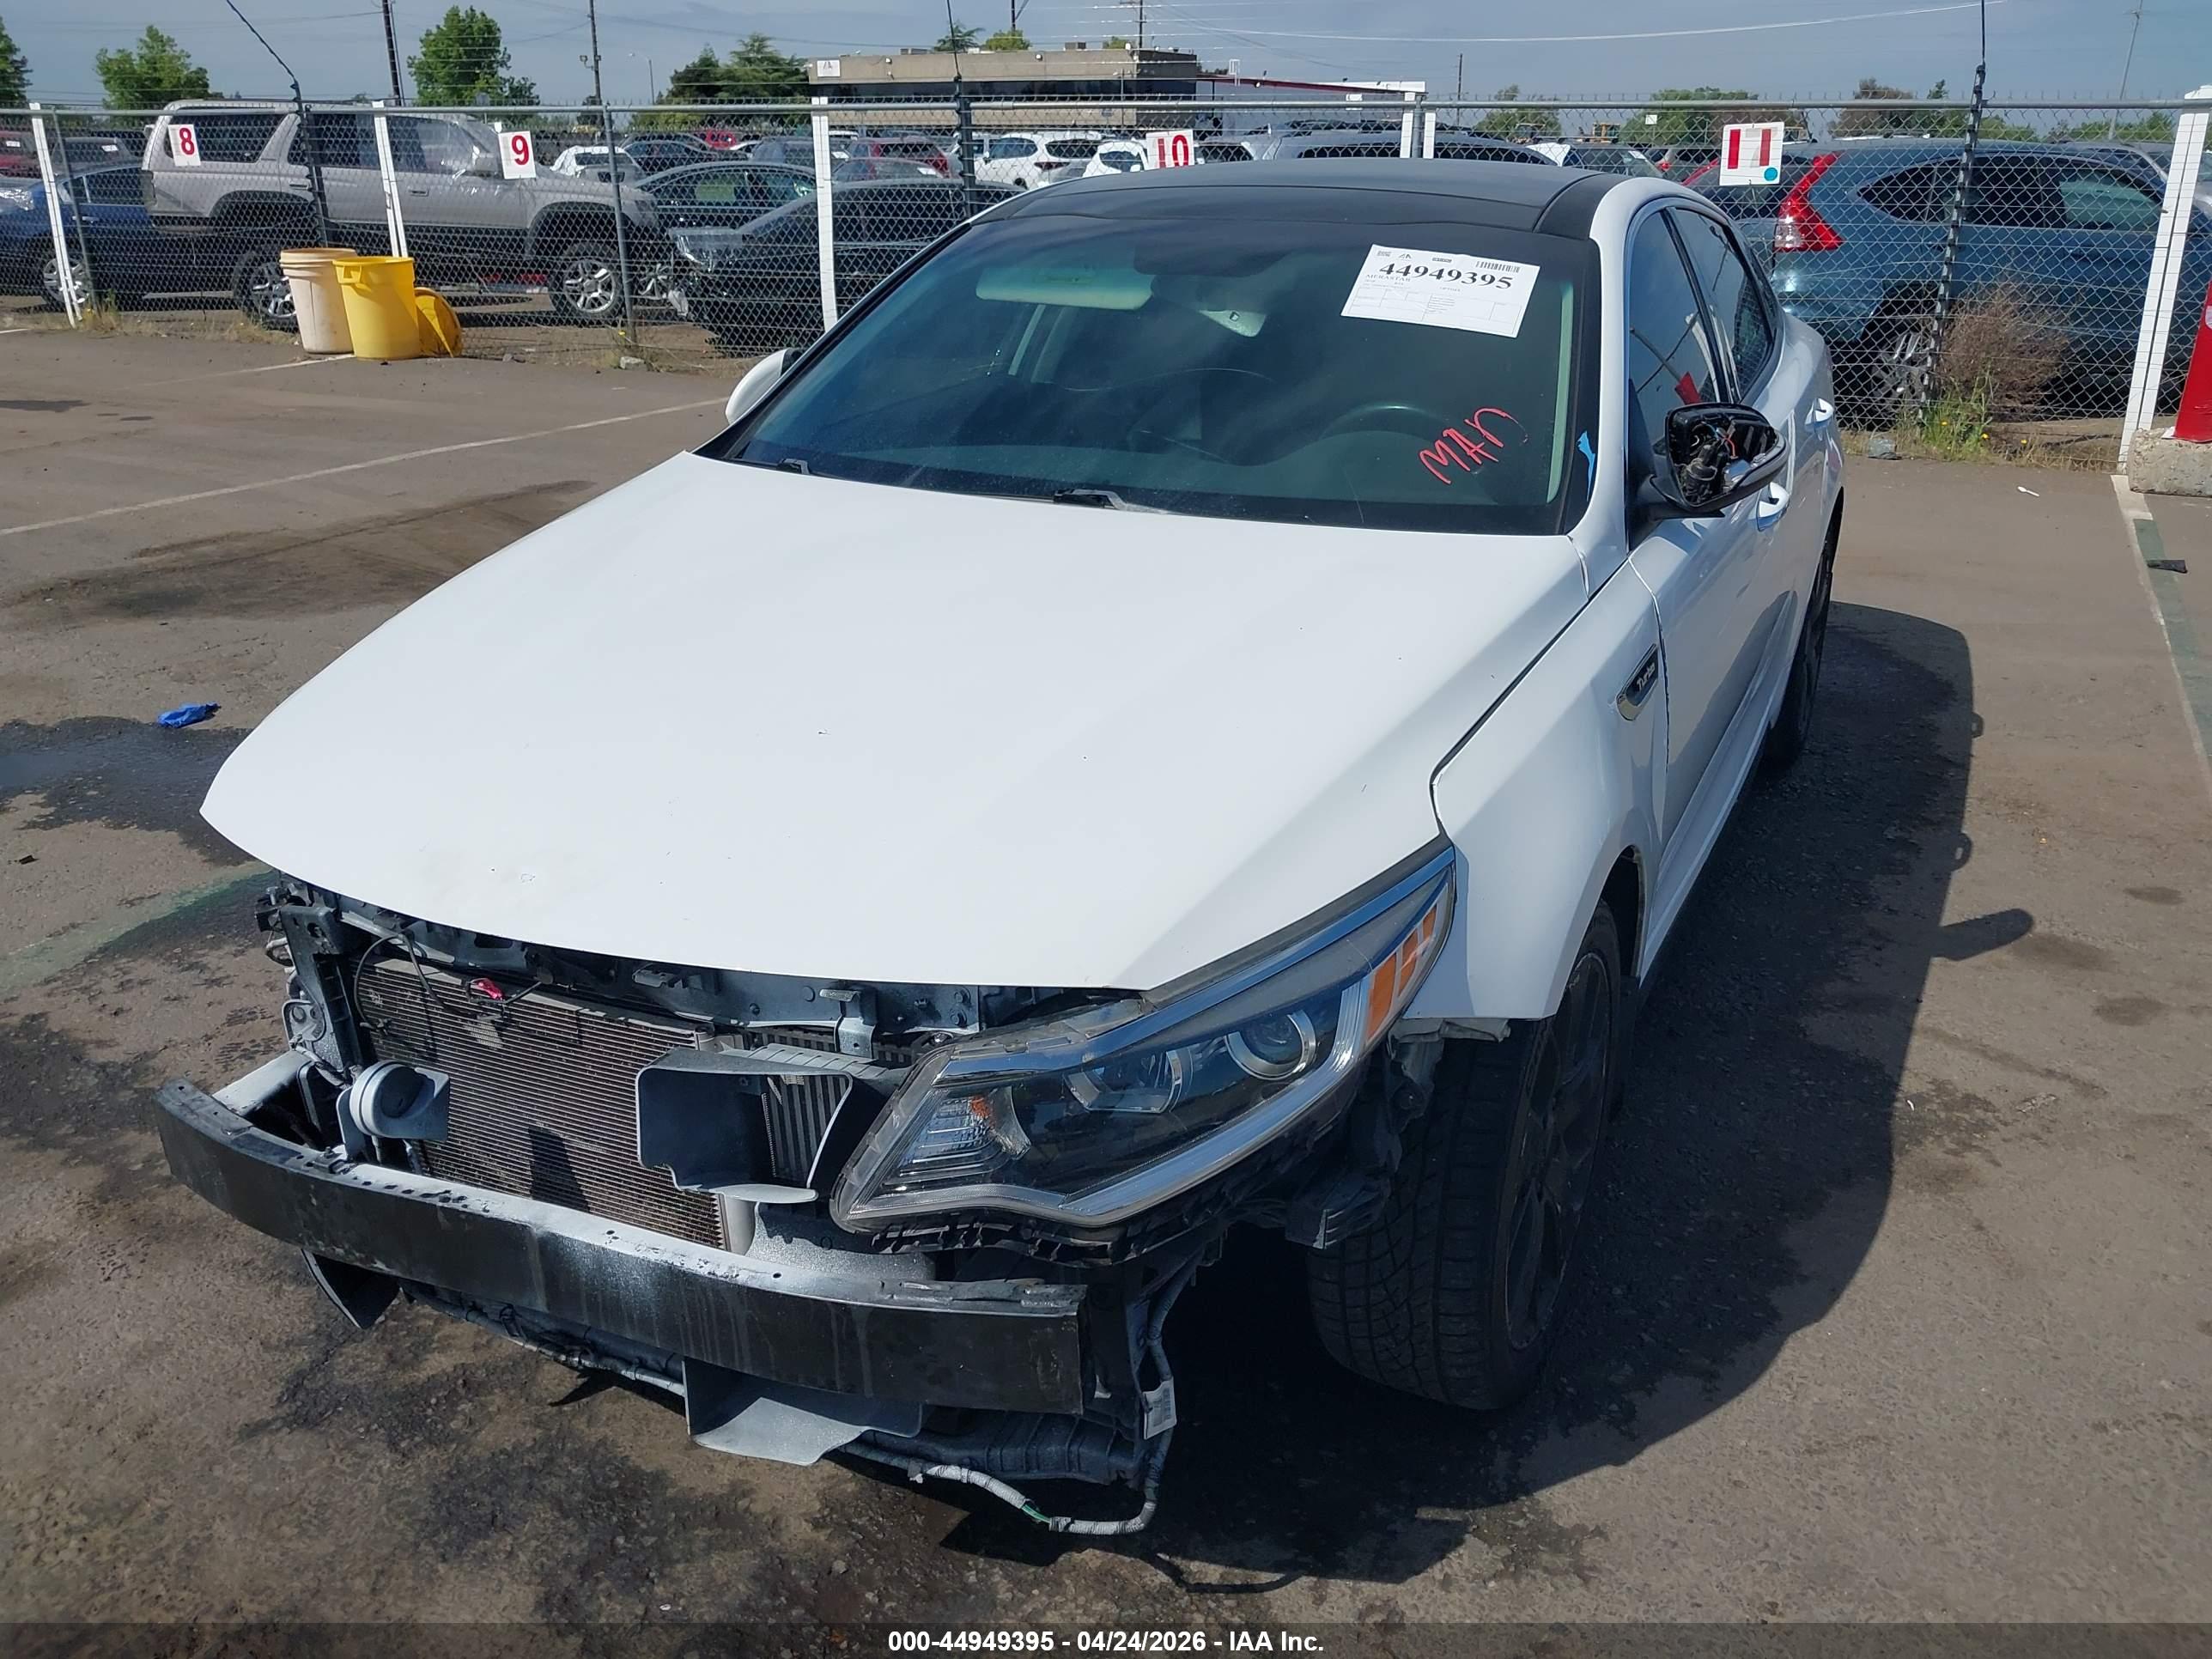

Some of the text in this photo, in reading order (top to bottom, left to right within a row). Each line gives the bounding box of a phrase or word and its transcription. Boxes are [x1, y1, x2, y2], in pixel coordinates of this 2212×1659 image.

[179, 127, 195, 155] 8
[511, 135, 530, 166] 9
[1157, 134, 1189, 167] 10
[1727, 128, 1771, 170] 11
[1379, 263, 1514, 289] 44949395
